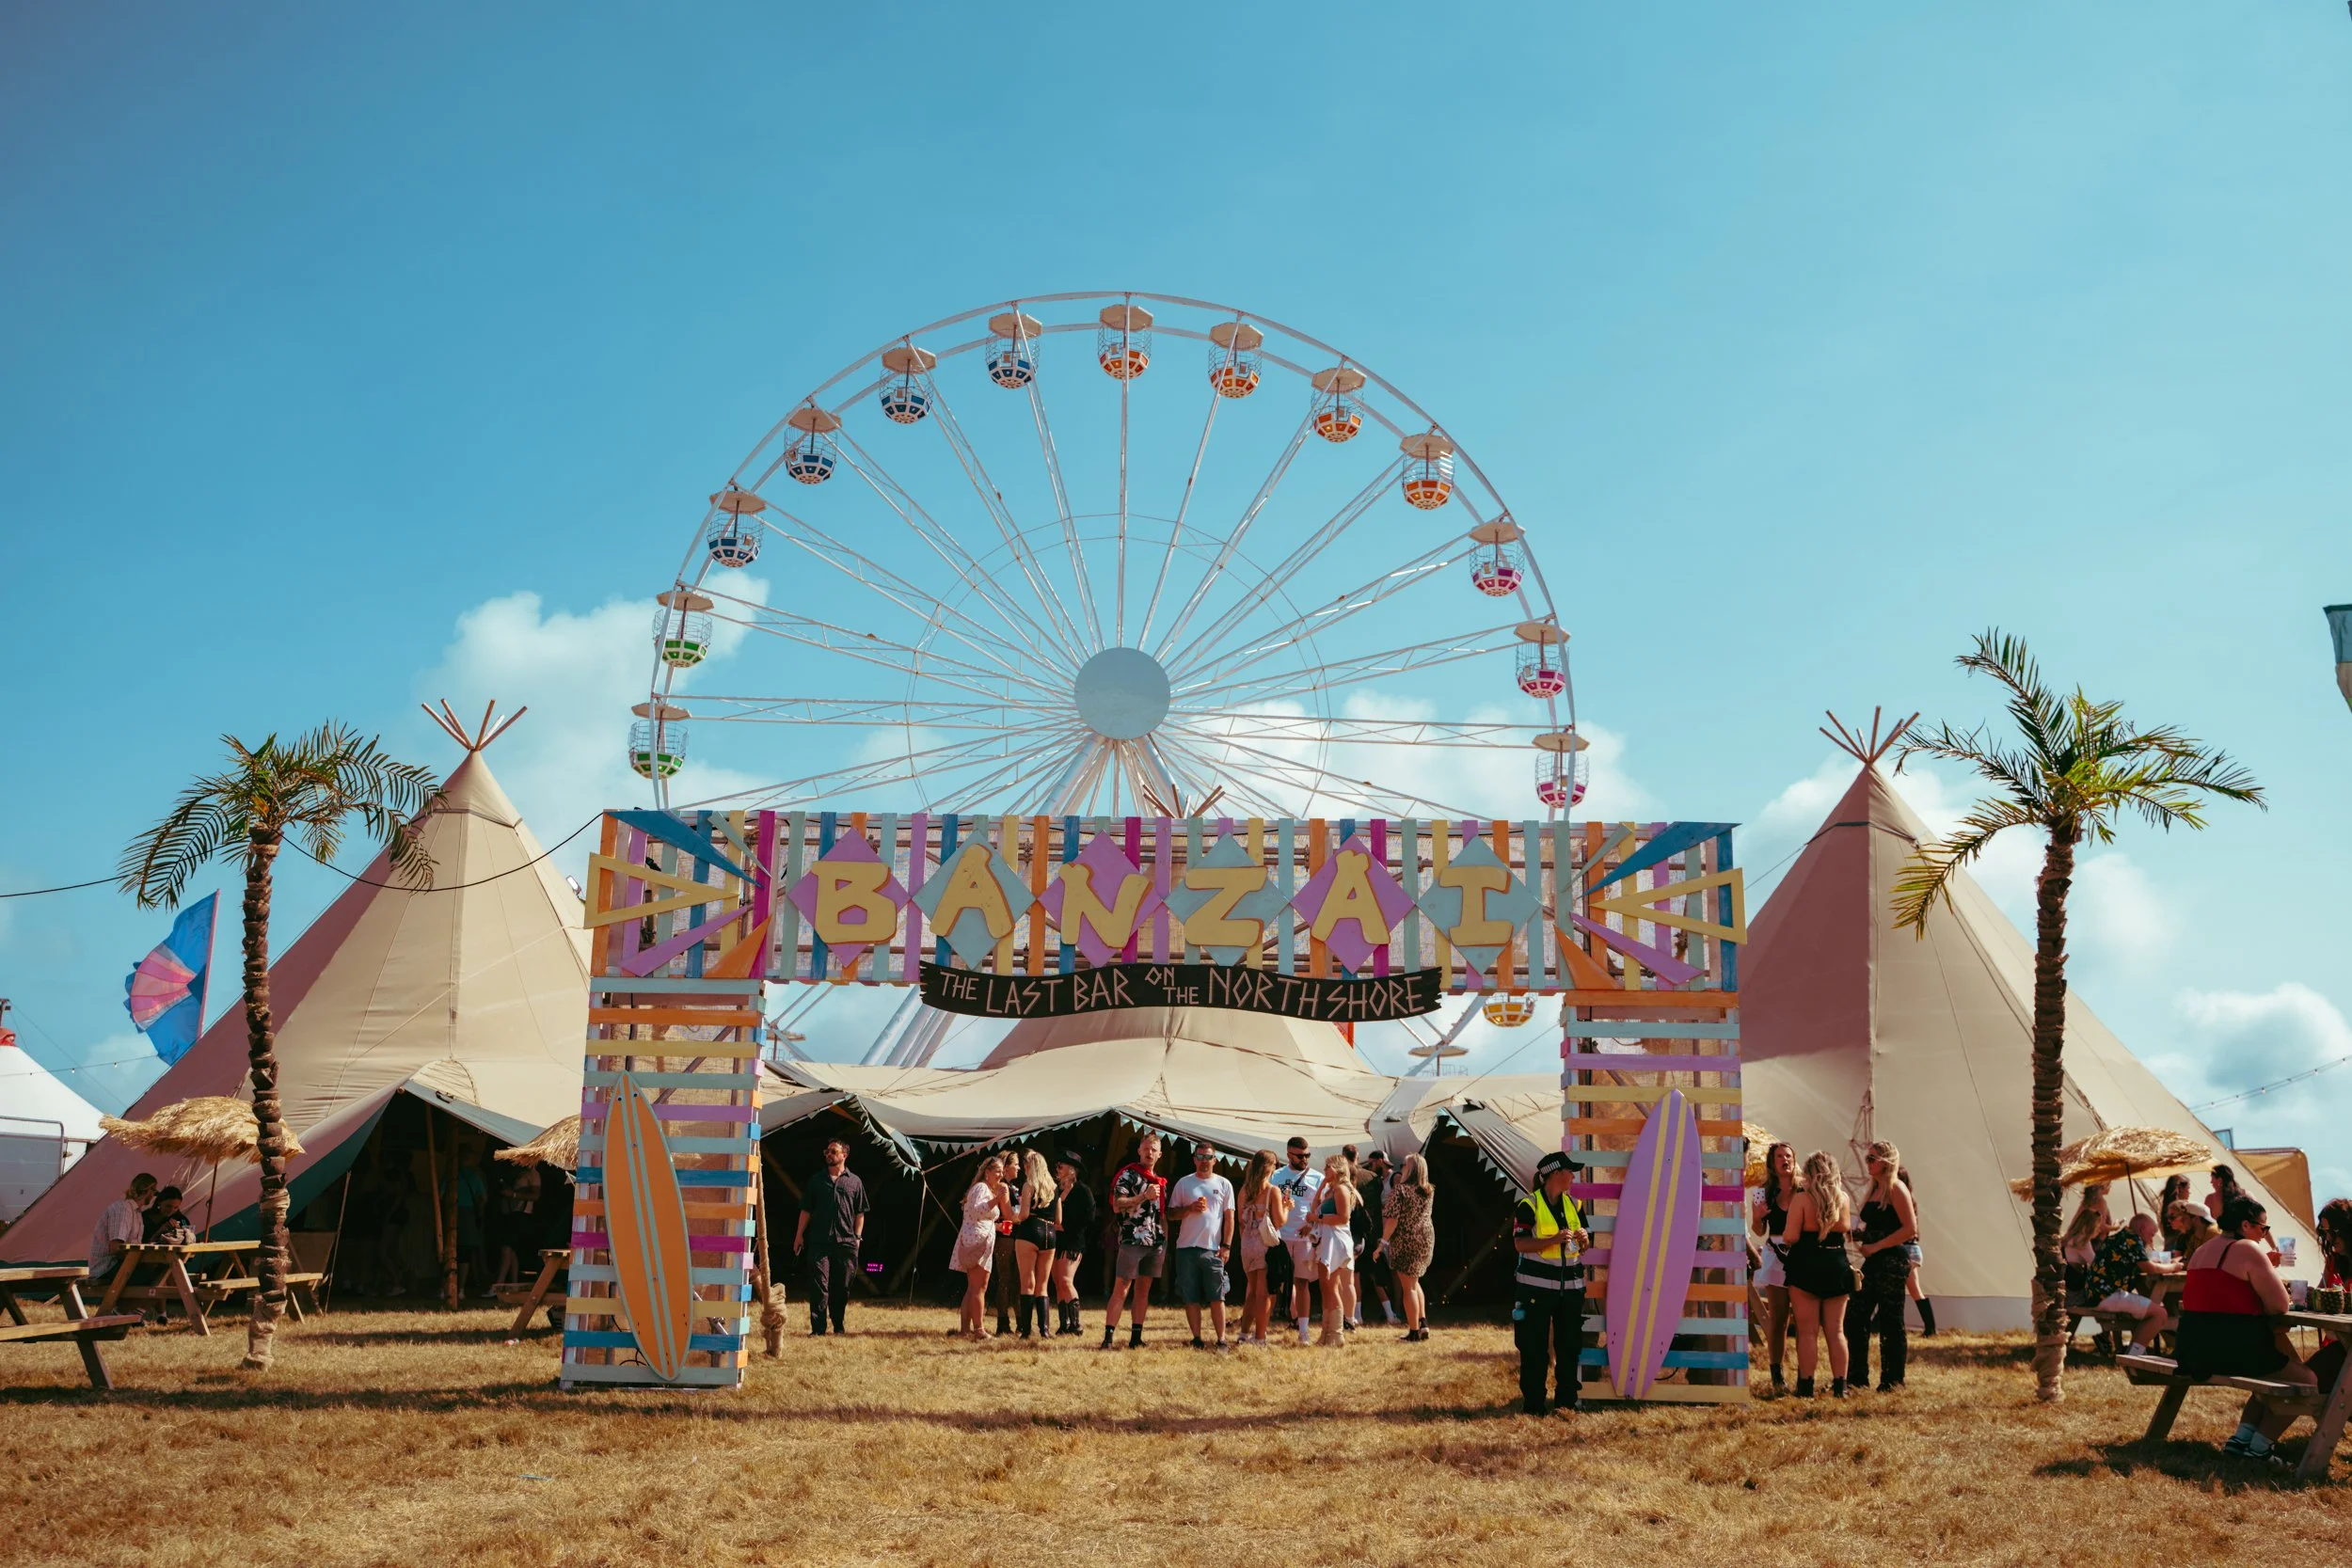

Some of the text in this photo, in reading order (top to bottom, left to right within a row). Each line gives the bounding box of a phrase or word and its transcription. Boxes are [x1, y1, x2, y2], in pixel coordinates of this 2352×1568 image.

[811, 843, 1514, 948] BANZAI
[940, 966, 1425, 1020] THE LAST BAR ON THE NORTH SHORE
